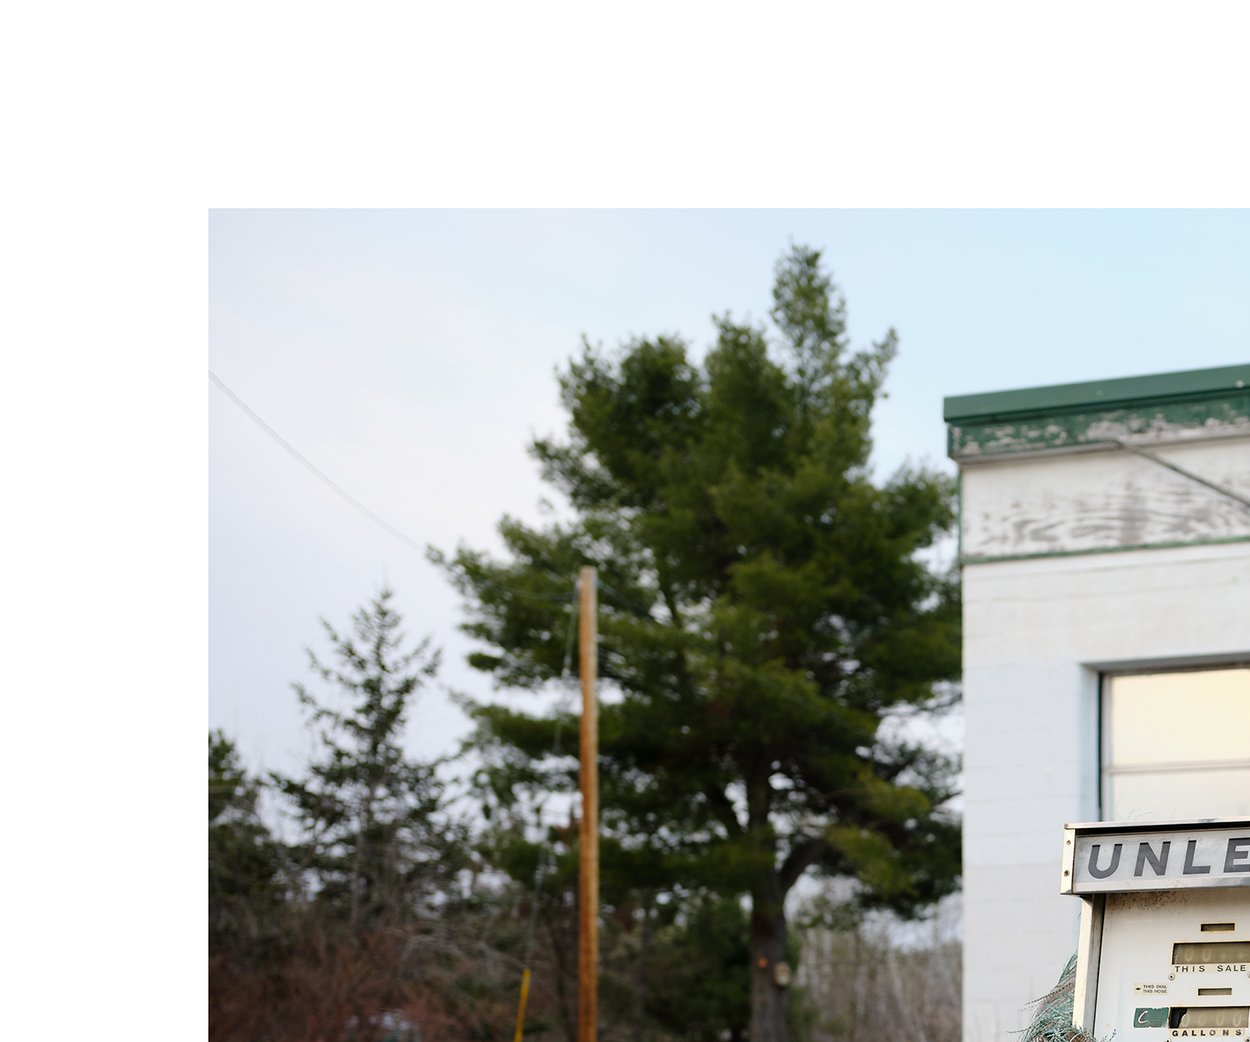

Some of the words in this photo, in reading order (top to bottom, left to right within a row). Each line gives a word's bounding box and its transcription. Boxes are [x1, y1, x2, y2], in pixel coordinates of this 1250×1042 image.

[1174, 965, 1206, 973] THIS
[1216, 964, 1246, 972] SALE
[1171, 1029, 1242, 1037] GALLONS
